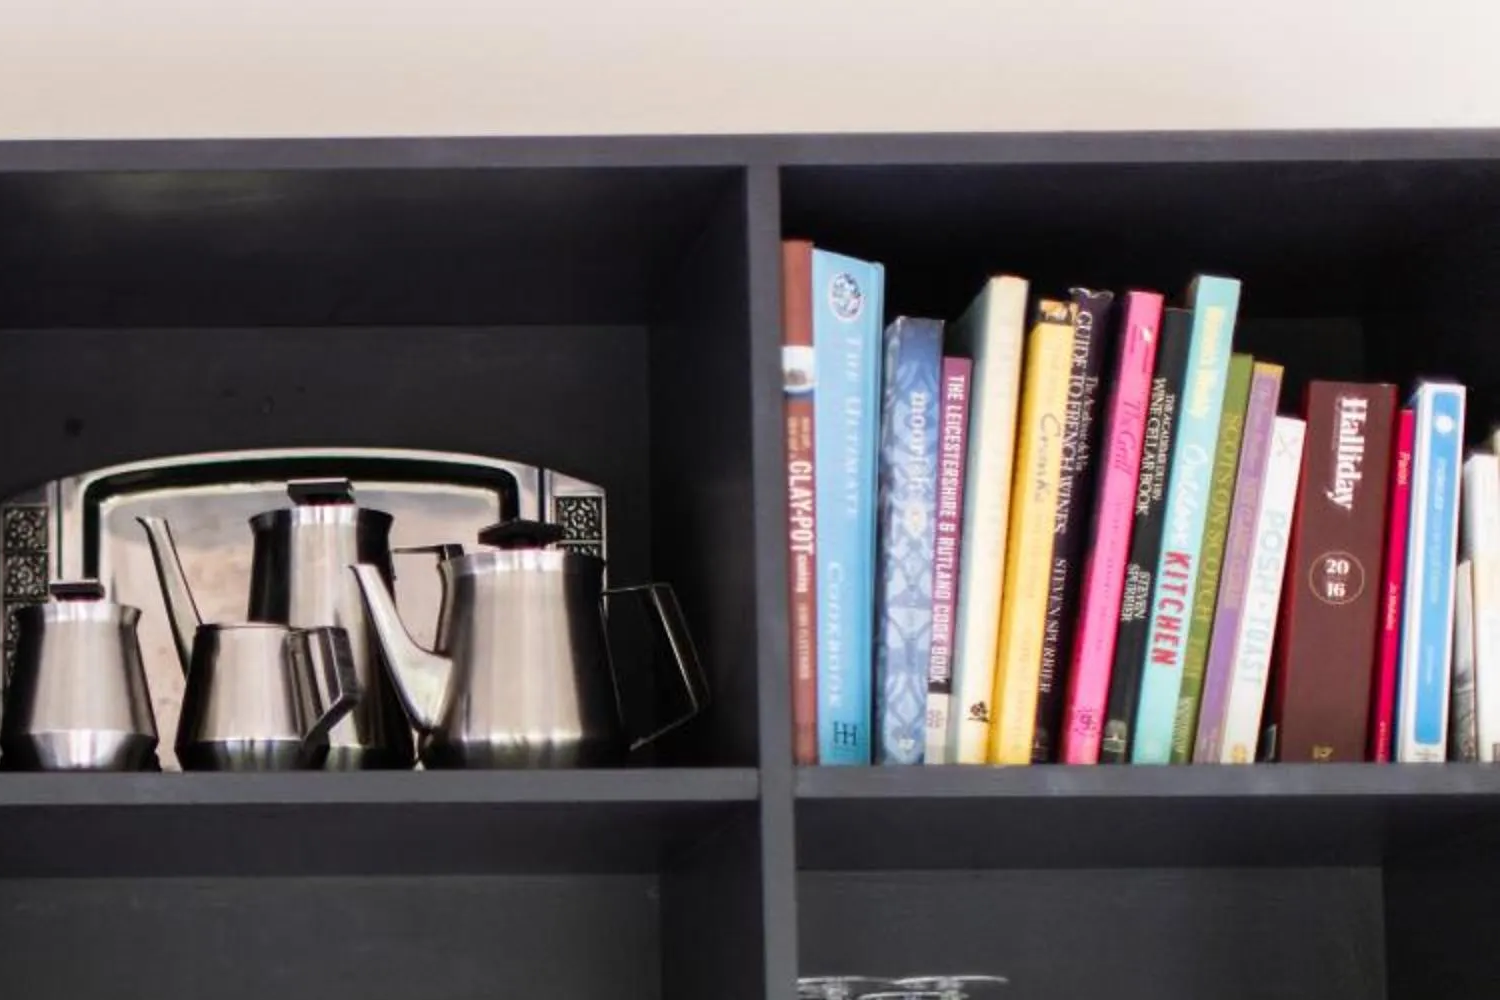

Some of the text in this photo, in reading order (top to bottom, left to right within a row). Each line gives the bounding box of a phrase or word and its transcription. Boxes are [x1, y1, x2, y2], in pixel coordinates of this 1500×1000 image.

[947, 375, 965, 400] THE
[1053, 310, 1093, 534] GUIDE TO FRENCH WINES
[940, 404, 962, 517] LEICESTERSHIRE
[1135, 377, 1168, 516] WINE CELLAR BOOK
[1326, 396, 1368, 511] Halliday
[788, 460, 815, 555] CLAY-POT
[1195, 413, 1242, 621] SCOTS ON SCOTCH
[934, 537, 956, 599] RUTLAND
[1255, 510, 1287, 593] POSH
[1325, 558, 1350, 575] 20
[932, 605, 950, 642] COOK
[1120, 563, 1140, 622] SPURRIER
[1135, 571, 1151, 619] STEVEN
[1151, 550, 1192, 666] KITCHEN
[1326, 582, 1346, 598] 16
[929, 646, 948, 684] BOOK
[1242, 614, 1272, 687] TOAST
